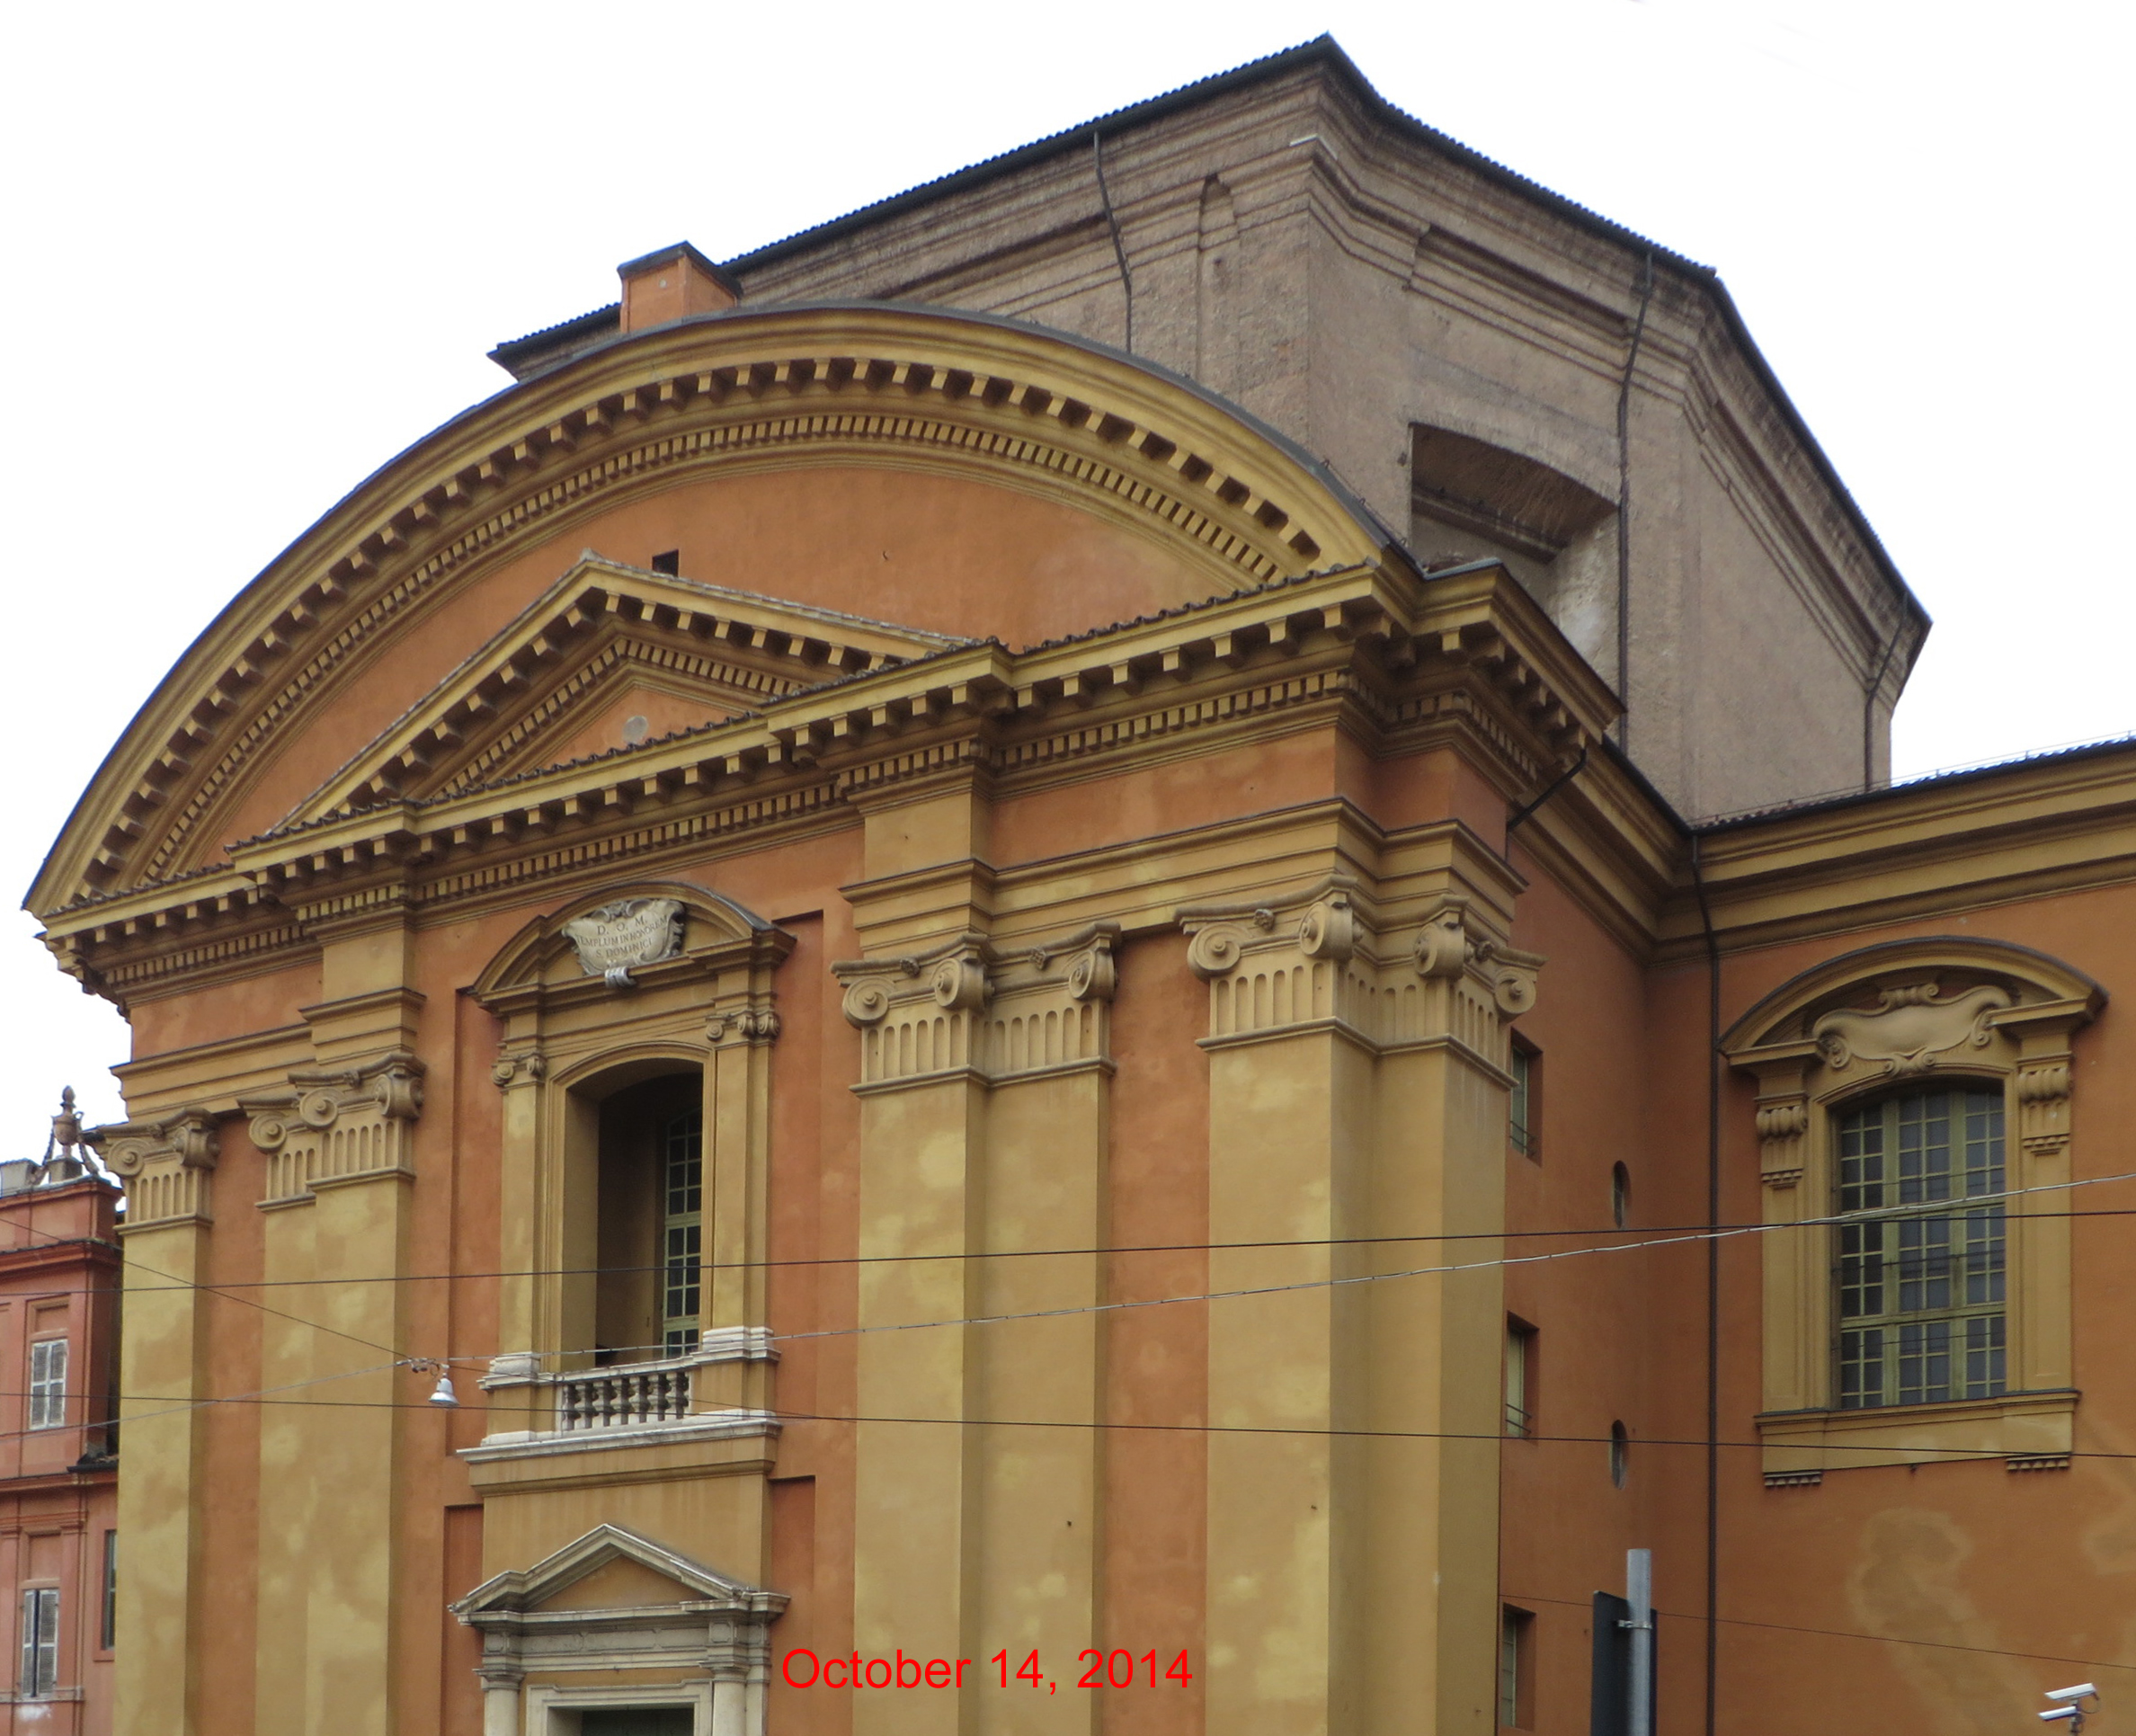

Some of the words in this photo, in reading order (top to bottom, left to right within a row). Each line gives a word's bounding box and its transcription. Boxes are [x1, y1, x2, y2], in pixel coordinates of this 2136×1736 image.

[577, 935, 619, 947] TEMPLUM
[619, 934, 629, 944] IN
[629, 914, 668, 941] HONOREM
[597, 925, 610, 935] D.
[616, 922, 628, 932] O.
[635, 915, 647, 927] M.
[606, 938, 653, 957] DOMINICI
